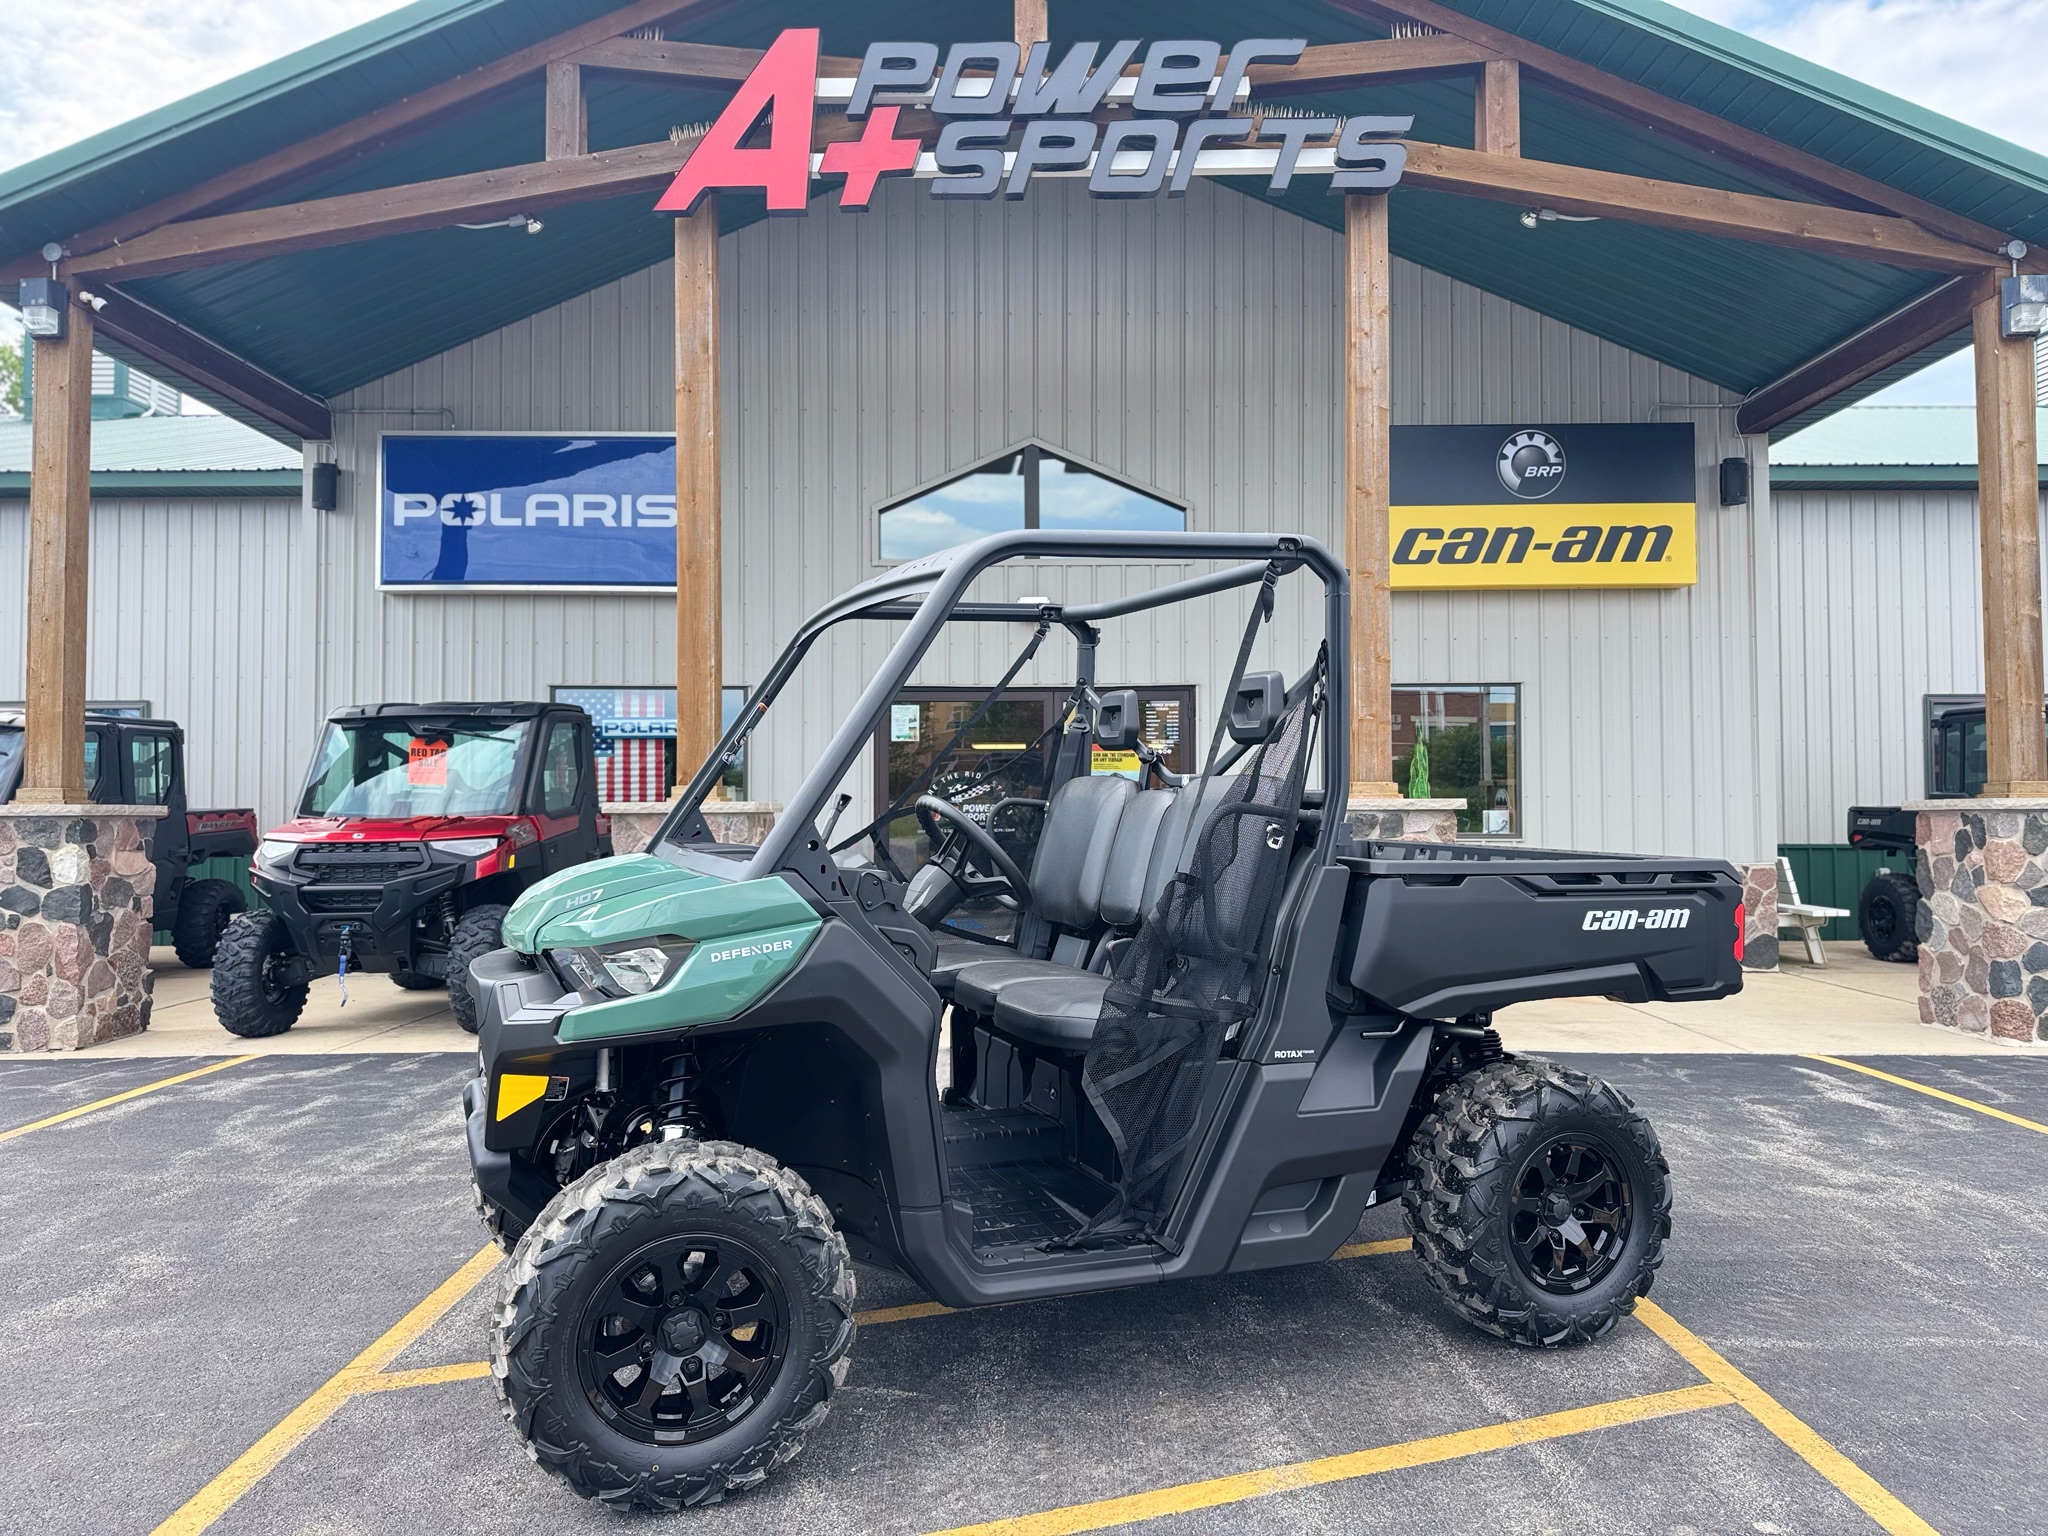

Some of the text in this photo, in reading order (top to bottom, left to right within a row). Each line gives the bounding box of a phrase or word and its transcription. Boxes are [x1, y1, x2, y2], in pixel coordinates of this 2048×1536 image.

[1524, 466, 1563, 477] BRP
[393, 493, 677, 528] POLARIS
[604, 722, 677, 733] POLAR
[411, 748, 446, 757] RED TAG
[418, 758, 438, 767] SALE
[940, 772, 959, 783] THE
[964, 771, 982, 779] RID
[201, 821, 238, 829] RANGER
[566, 888, 604, 908] HD7
[1582, 908, 1691, 931] can-am
[711, 939, 793, 963] DEFENDER
[1274, 1050, 1303, 1059] ROTAX
